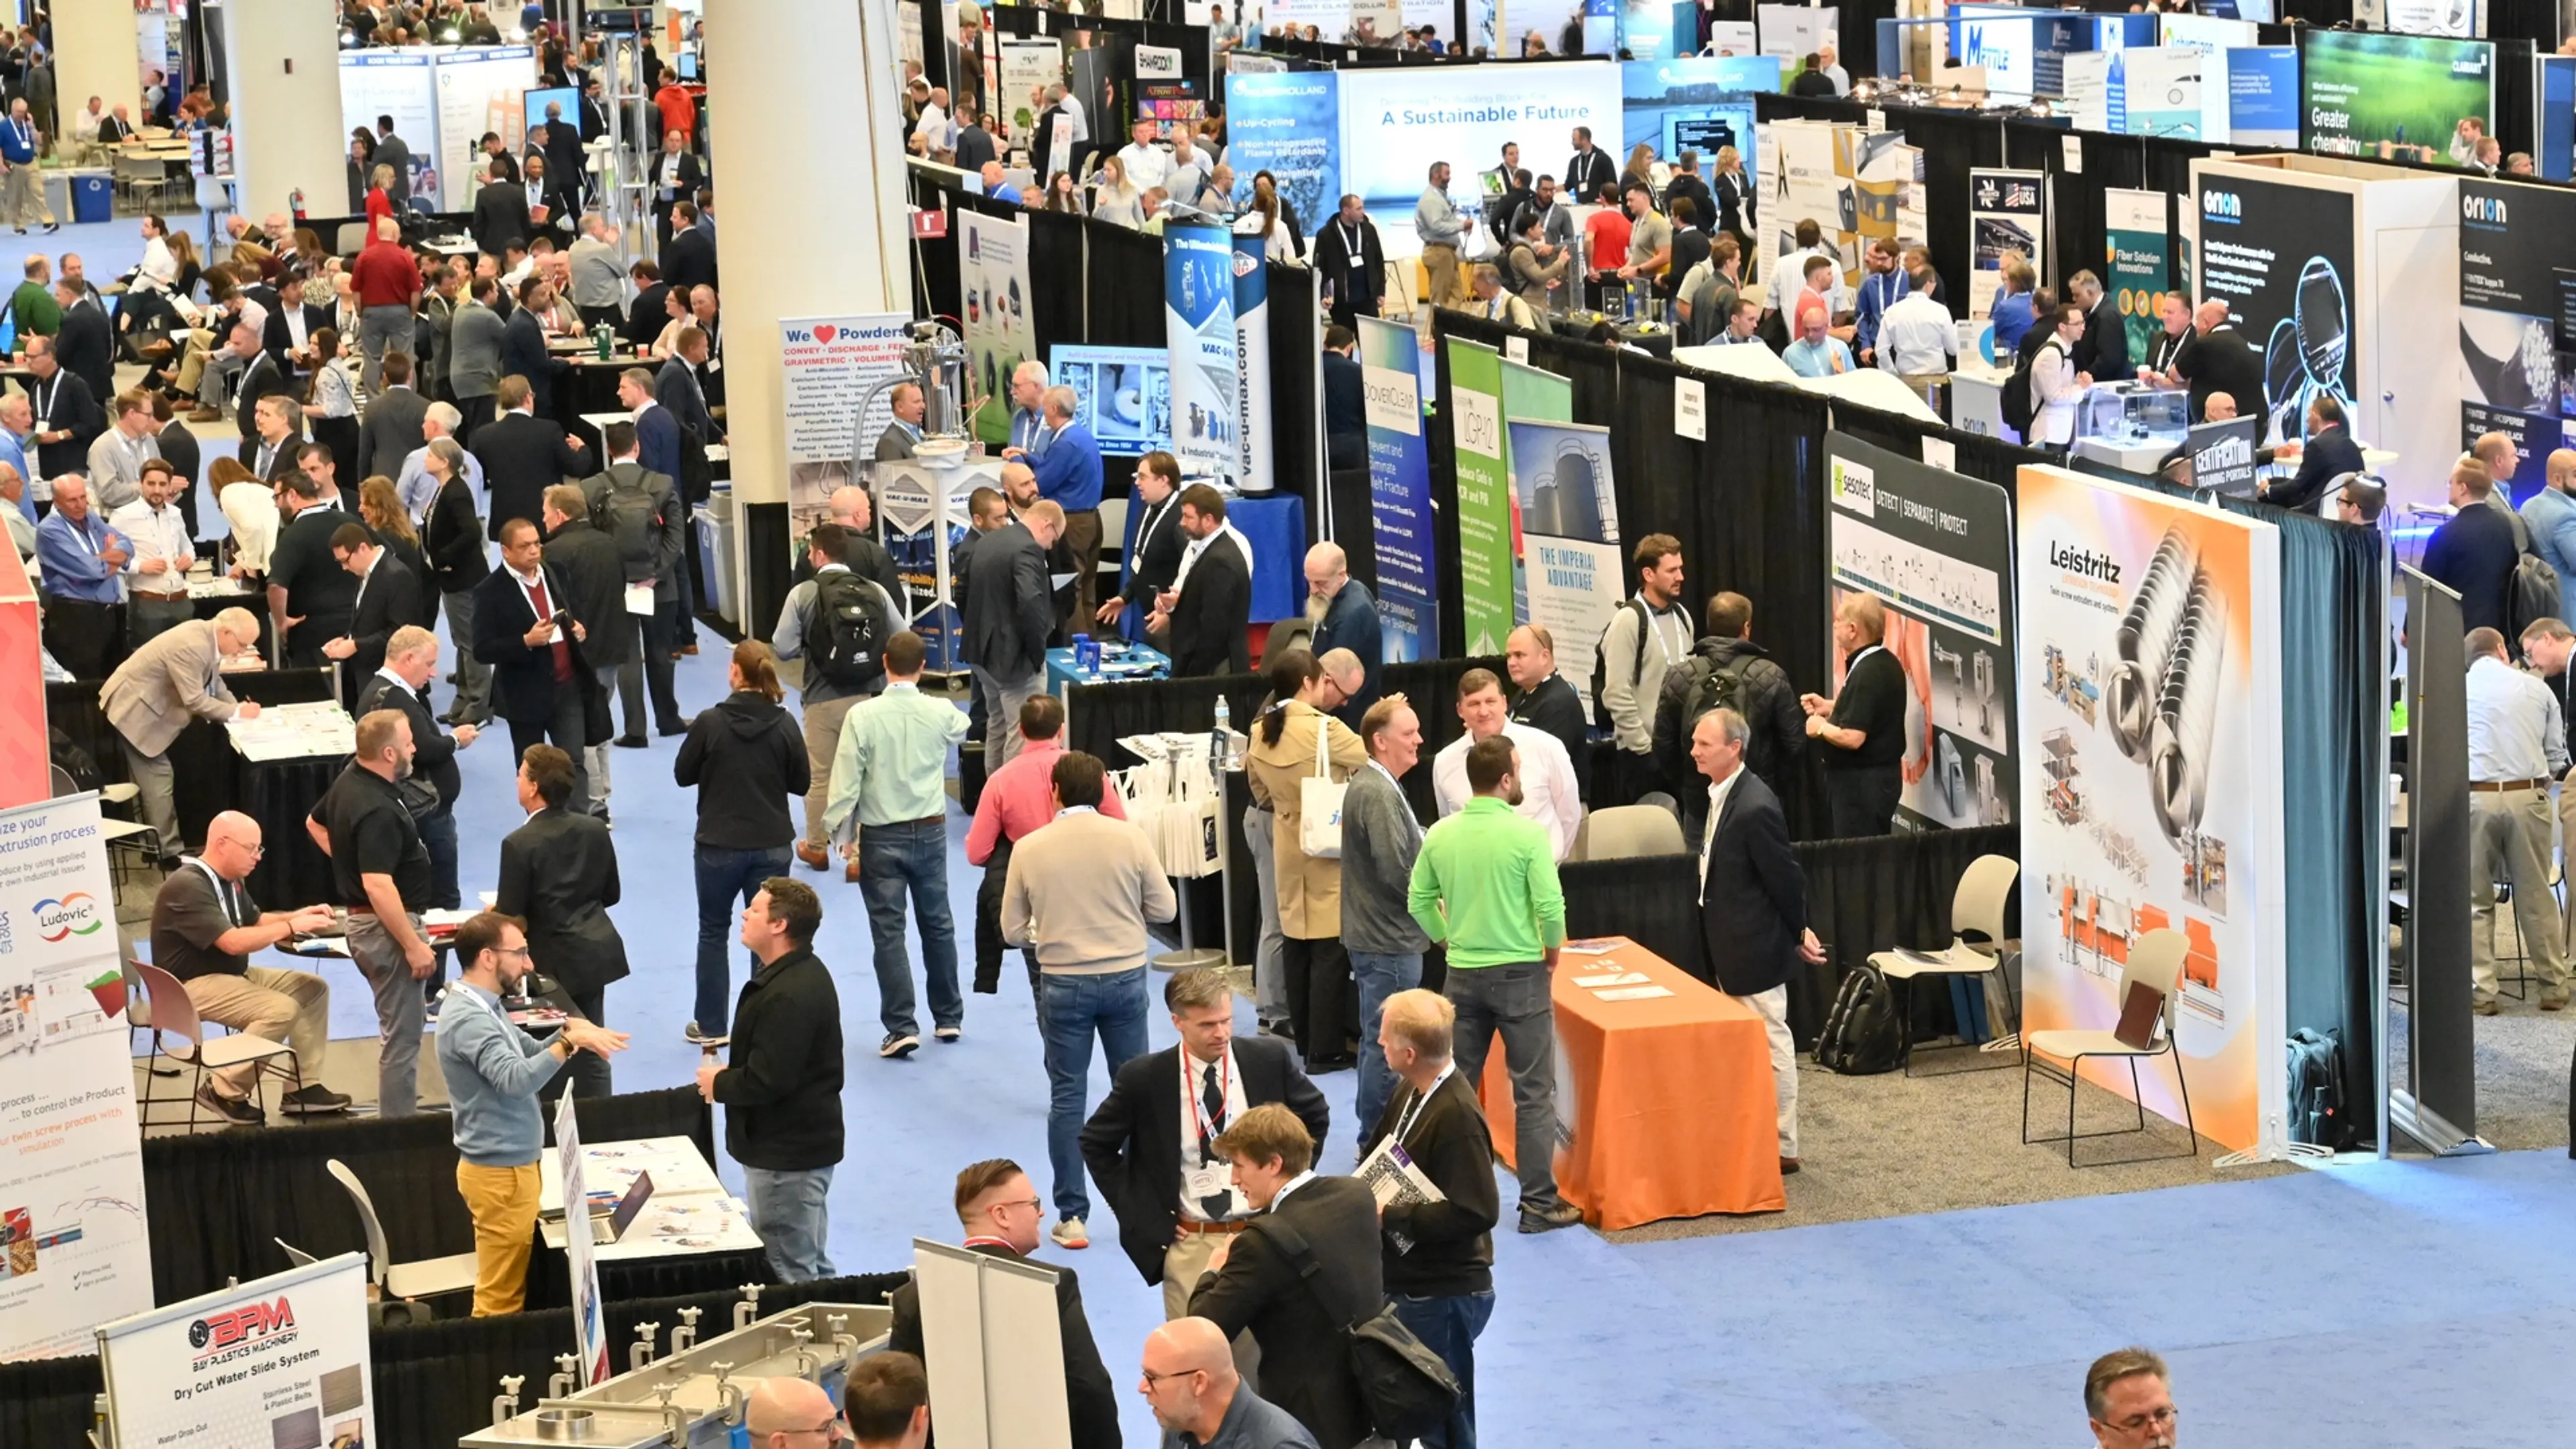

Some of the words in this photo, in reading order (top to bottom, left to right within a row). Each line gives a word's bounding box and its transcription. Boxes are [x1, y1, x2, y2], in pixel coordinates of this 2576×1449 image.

[2452, 60, 2481, 74] CLARIANT
[1243, 117, 1295, 127] Up-Cycling
[1382, 111, 1395, 125] A
[1403, 106, 1517, 125] Sustainable
[1525, 105, 1589, 120] Future
[2312, 106, 2349, 129] Greater
[1244, 138, 1326, 149] Non-Halogenated
[1244, 150, 1273, 158] Flame
[1276, 147, 1326, 156] Retardants
[2312, 131, 2361, 156] chemistry
[2019, 191, 2035, 206] USA
[2204, 190, 2241, 216] orion
[2463, 195, 2507, 223] orion
[2116, 249, 2133, 261] Fiber
[2134, 251, 2161, 264] Solution
[2117, 260, 2153, 275] Innovations
[786, 329, 811, 342] We
[840, 326, 904, 340] Powders
[784, 347, 820, 356] CONVEY
[828, 345, 880, 354] DISCHARGE
[784, 356, 846, 366] GRAVIMETRIC
[1237, 329, 1252, 476] vac-u-max.com
[1187, 446, 1215, 459] Industrial
[1477, 468, 1487, 485] Gels
[2197, 471, 2225, 489] TRAINING
[2226, 466, 2252, 484] PORTALS
[1469, 488, 1479, 504] and
[1843, 474, 1871, 500] sesotec
[886, 493, 928, 504] VAC-U-MAX
[1876, 488, 1898, 513] DETECT
[1904, 499, 1934, 525] SEPARATE
[1939, 511, 1968, 536] PROTECT
[1540, 547, 1556, 565] THE
[1558, 549, 1596, 572] IMPERIAL
[2049, 539, 2121, 584] Leistritz
[1548, 569, 1593, 592] ADVANTAGE
[2061, 590, 2072, 600] screw
[2074, 594, 2092, 607] extruders
[2093, 600, 2101, 609] and
[2103, 602, 2118, 615] systems
[20, 816, 48, 833] your
[51, 825, 97, 845] process
[23, 863, 33, 871] by
[36, 857, 55, 868] using
[56, 851, 86, 863] applied
[24, 869, 60, 882] industrial
[62, 863, 85, 874] issues
[1, 1093, 36, 1112] process
[21, 1110, 32, 1118] to
[34, 1099, 67, 1115] control
[70, 1095, 84, 1107] the
[86, 1085, 126, 1101] Product
[12, 1130, 32, 1143] twin
[35, 1123, 62, 1137] screw
[64, 1113, 97, 1131] process
[100, 1108, 123, 1119] with
[19, 1137, 65, 1156] simulation
[207, 1295, 294, 1347] BPM
[193, 1358, 208, 1373] BAY
[211, 1345, 250, 1366] PLASTICS
[253, 1331, 299, 1354] MACHINERY
[174, 1387, 193, 1401] Dry
[196, 1380, 213, 1393] Cut
[216, 1371, 248, 1387] Water
[251, 1360, 276, 1377] Slide
[279, 1348, 321, 1367] System
[262, 1385, 292, 1401] Stainless
[294, 1379, 312, 1391] Steel
[271, 1397, 292, 1409] Plastic
[157, 1434, 176, 1445] Water
[178, 1428, 195, 1440] Drop
